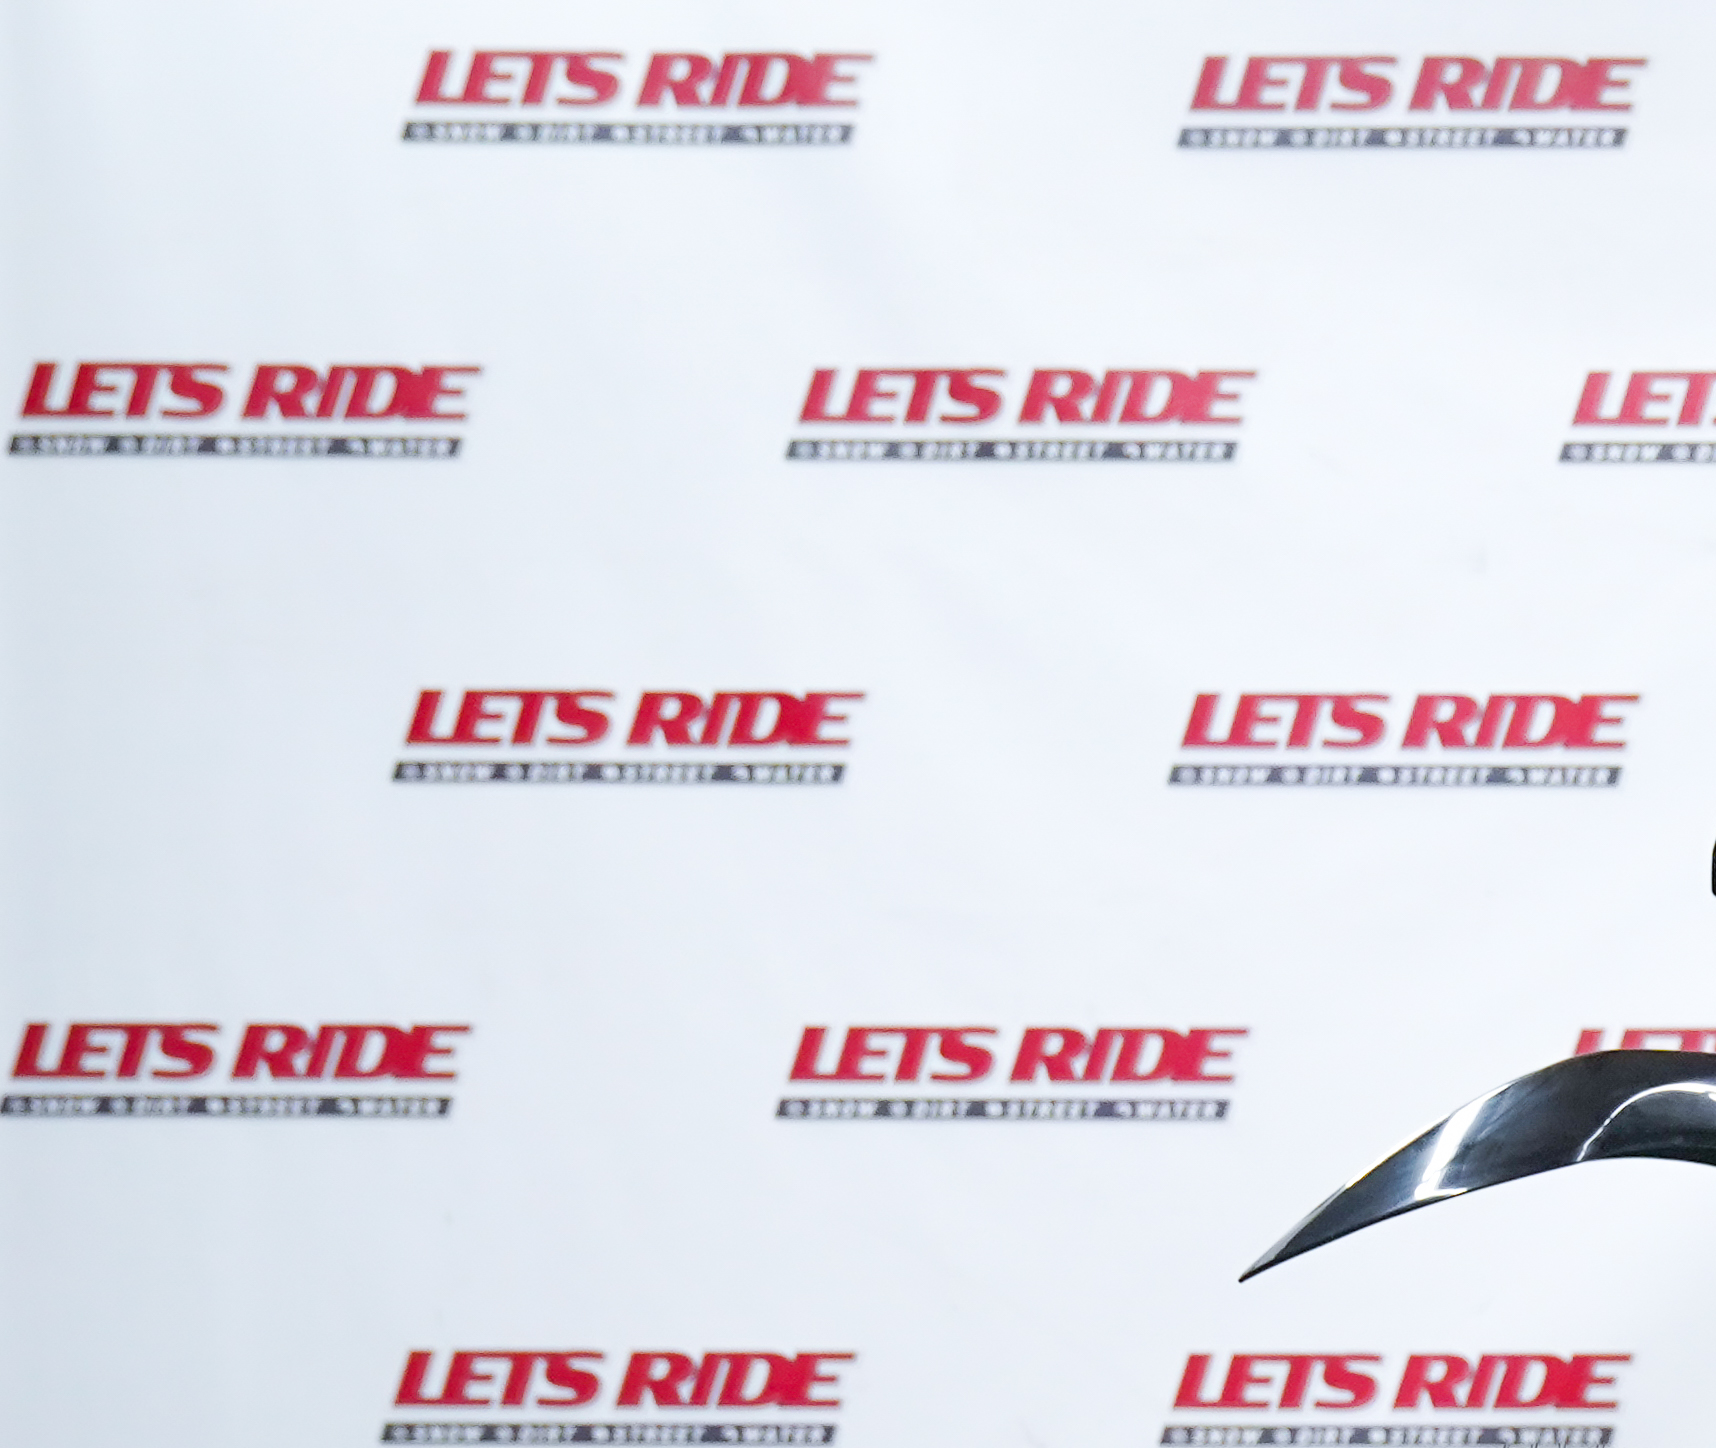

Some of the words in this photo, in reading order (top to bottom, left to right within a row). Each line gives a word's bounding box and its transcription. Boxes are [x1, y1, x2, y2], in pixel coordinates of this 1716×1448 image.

[416, 51, 620, 104] LETS
[638, 53, 872, 106] RIDE
[1192, 57, 1393, 109] LETS
[1411, 57, 1645, 109] RIDE
[22, 362, 227, 417] LETS
[242, 365, 479, 419] RIDE
[801, 368, 1003, 423] LETS
[1019, 369, 1256, 423] RIDE
[406, 690, 613, 744] LETS
[627, 691, 863, 746] RIDE
[1182, 694, 1387, 747] LETS
[1402, 694, 1638, 748] RIDE
[12, 1023, 217, 1078] LETS
[232, 1024, 469, 1079] RIDE
[790, 1027, 996, 1081] LETS
[1010, 1028, 1247, 1082] RIDE
[395, 1351, 603, 1406] LETS
[616, 1352, 853, 1407] RIDE
[1174, 1354, 1380, 1408] LETS
[1394, 1354, 1630, 1409] RIDE
